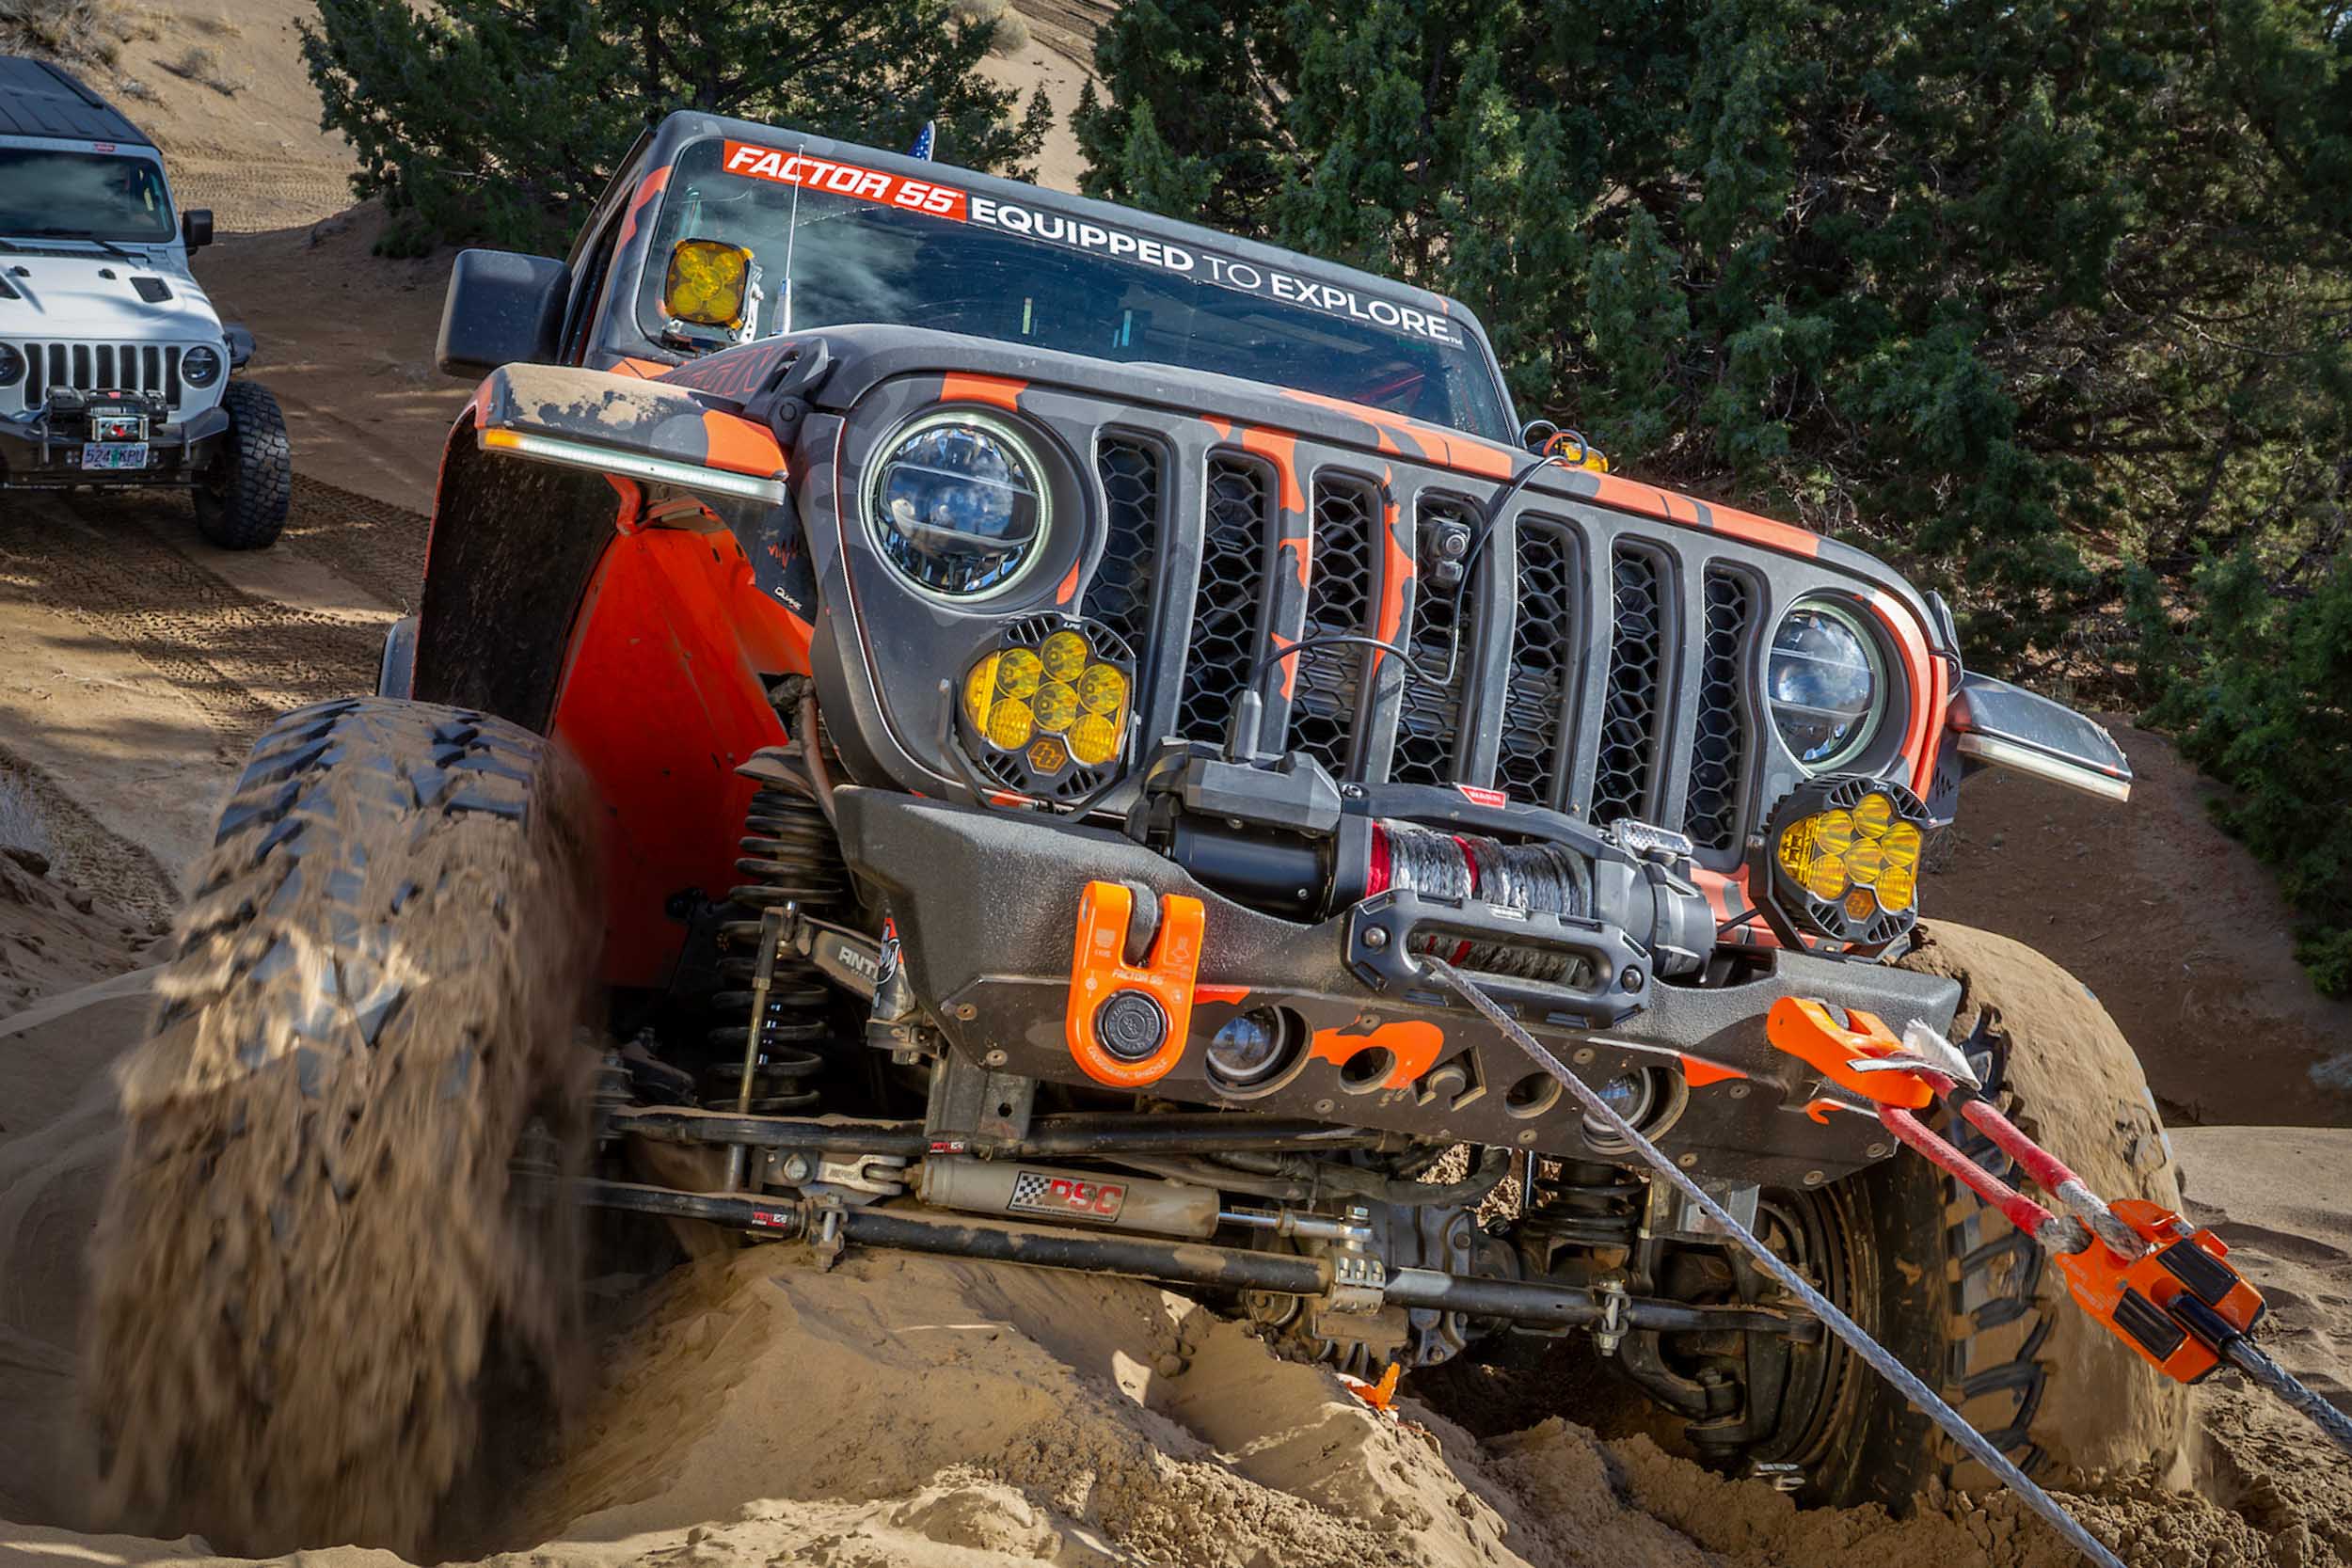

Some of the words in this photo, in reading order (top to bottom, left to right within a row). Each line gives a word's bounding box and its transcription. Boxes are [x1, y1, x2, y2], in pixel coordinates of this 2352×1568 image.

[727, 146, 893, 198] FACTOR
[895, 181, 958, 213] 55
[971, 197, 1194, 271] EQUIPPED
[1202, 255, 1262, 289] TO
[1270, 273, 1450, 341] EXPLORE
